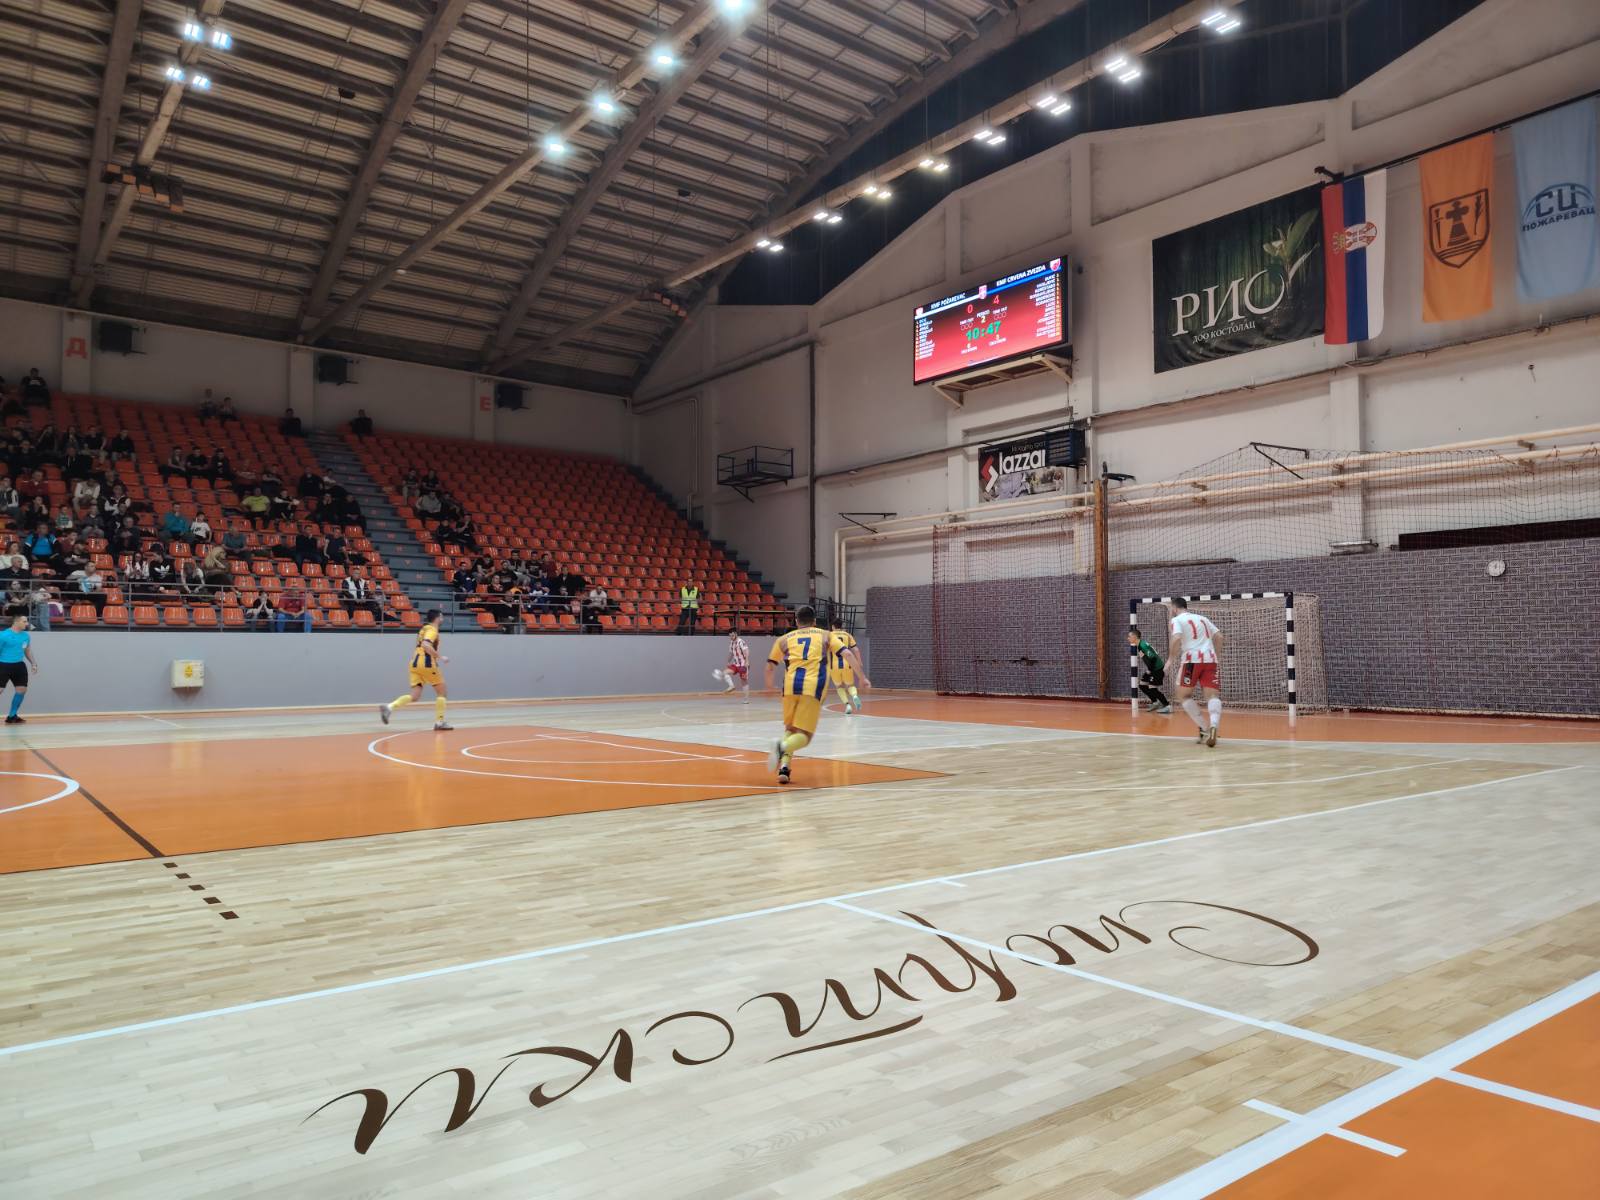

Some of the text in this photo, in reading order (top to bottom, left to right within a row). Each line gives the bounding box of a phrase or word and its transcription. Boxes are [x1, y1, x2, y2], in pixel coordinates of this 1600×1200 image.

[1521, 208, 1595, 232] ПОЖАРЕВАЦ
[1007, 272, 1026, 283] CRVENA
[1026, 265, 1046, 276] ZVEZDA
[967, 304, 973, 313] 0
[1171, 270, 1285, 336] РИО
[966, 321, 1001, 340] 10:47
[1210, 321, 1256, 338] КОСТОЛАЦ
[64, 337, 88, 358] Д
[1187, 619, 1210, 639] 11
[797, 637, 811, 660] 7
[299, 899, 1321, 1155] Спортски
